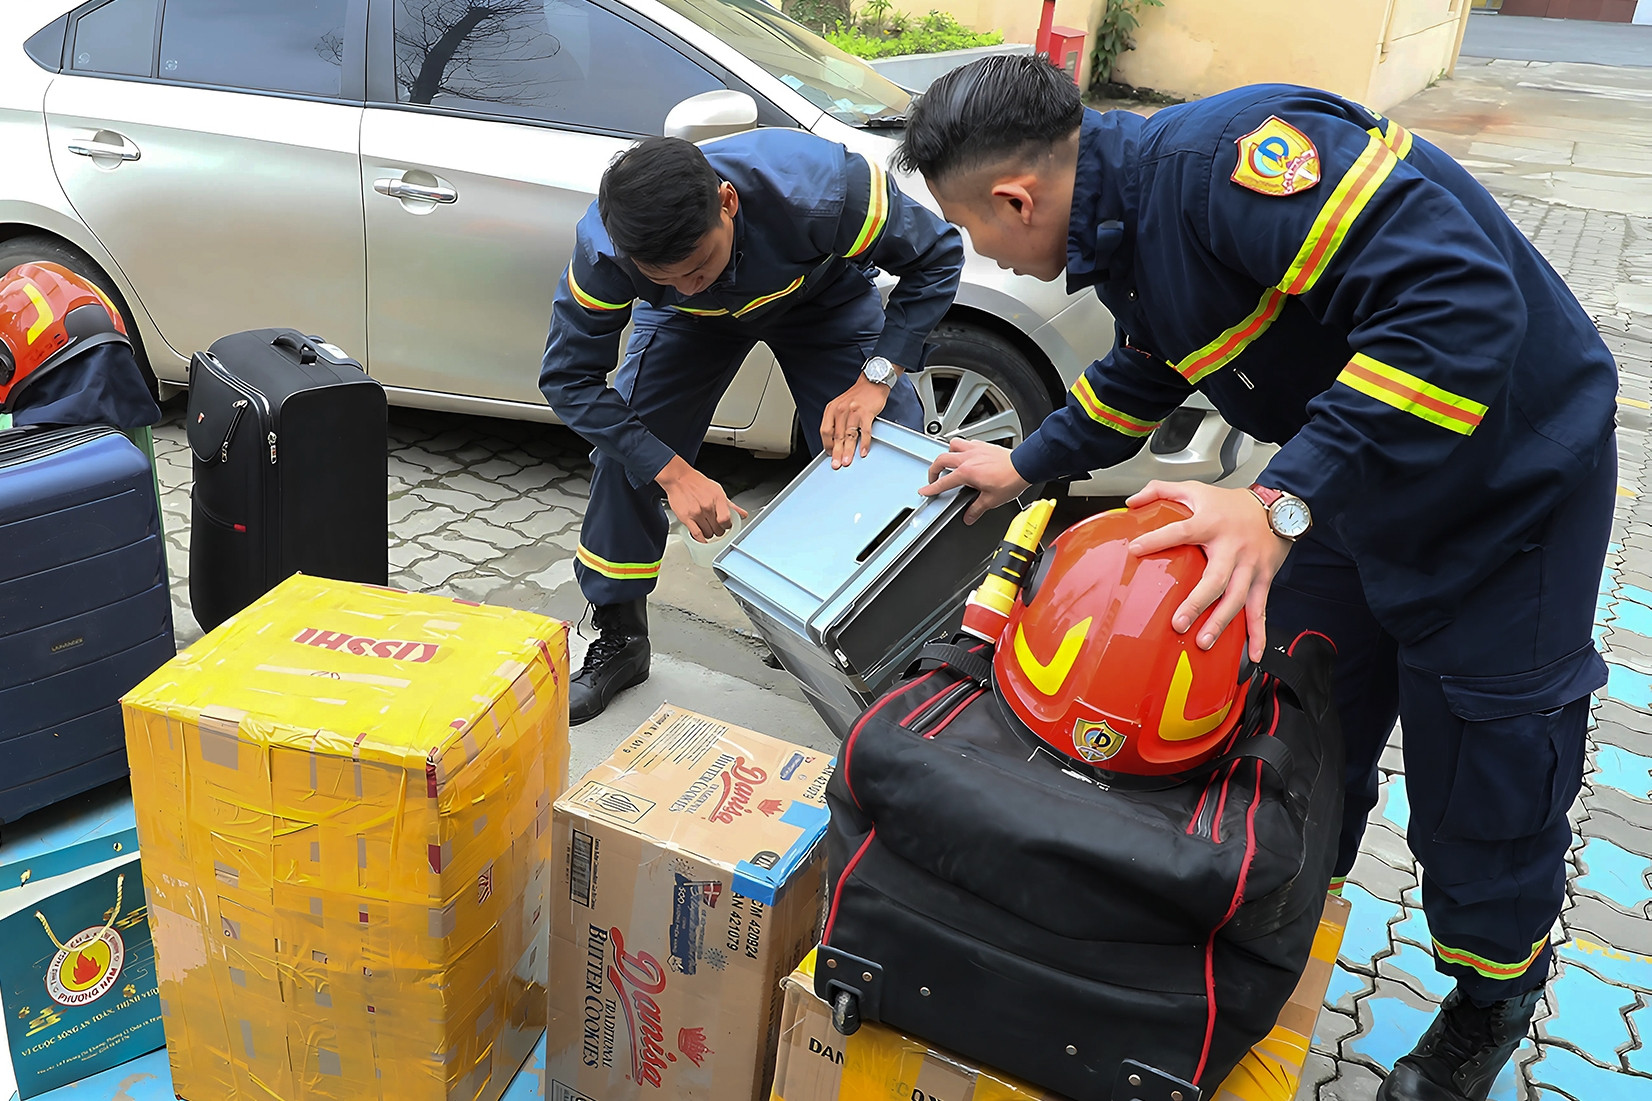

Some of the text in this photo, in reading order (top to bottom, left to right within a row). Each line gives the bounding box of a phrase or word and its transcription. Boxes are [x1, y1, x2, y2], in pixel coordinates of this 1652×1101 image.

[708, 755, 768, 825] Danisa
[585, 922, 610, 995] BUTTER
[726, 911, 742, 952] 421079
[744, 919, 762, 960] 420924
[582, 994, 605, 1070] COOKIES
[602, 998, 617, 1069] TRADITIONAL
[607, 926, 677, 1088] Danisa
